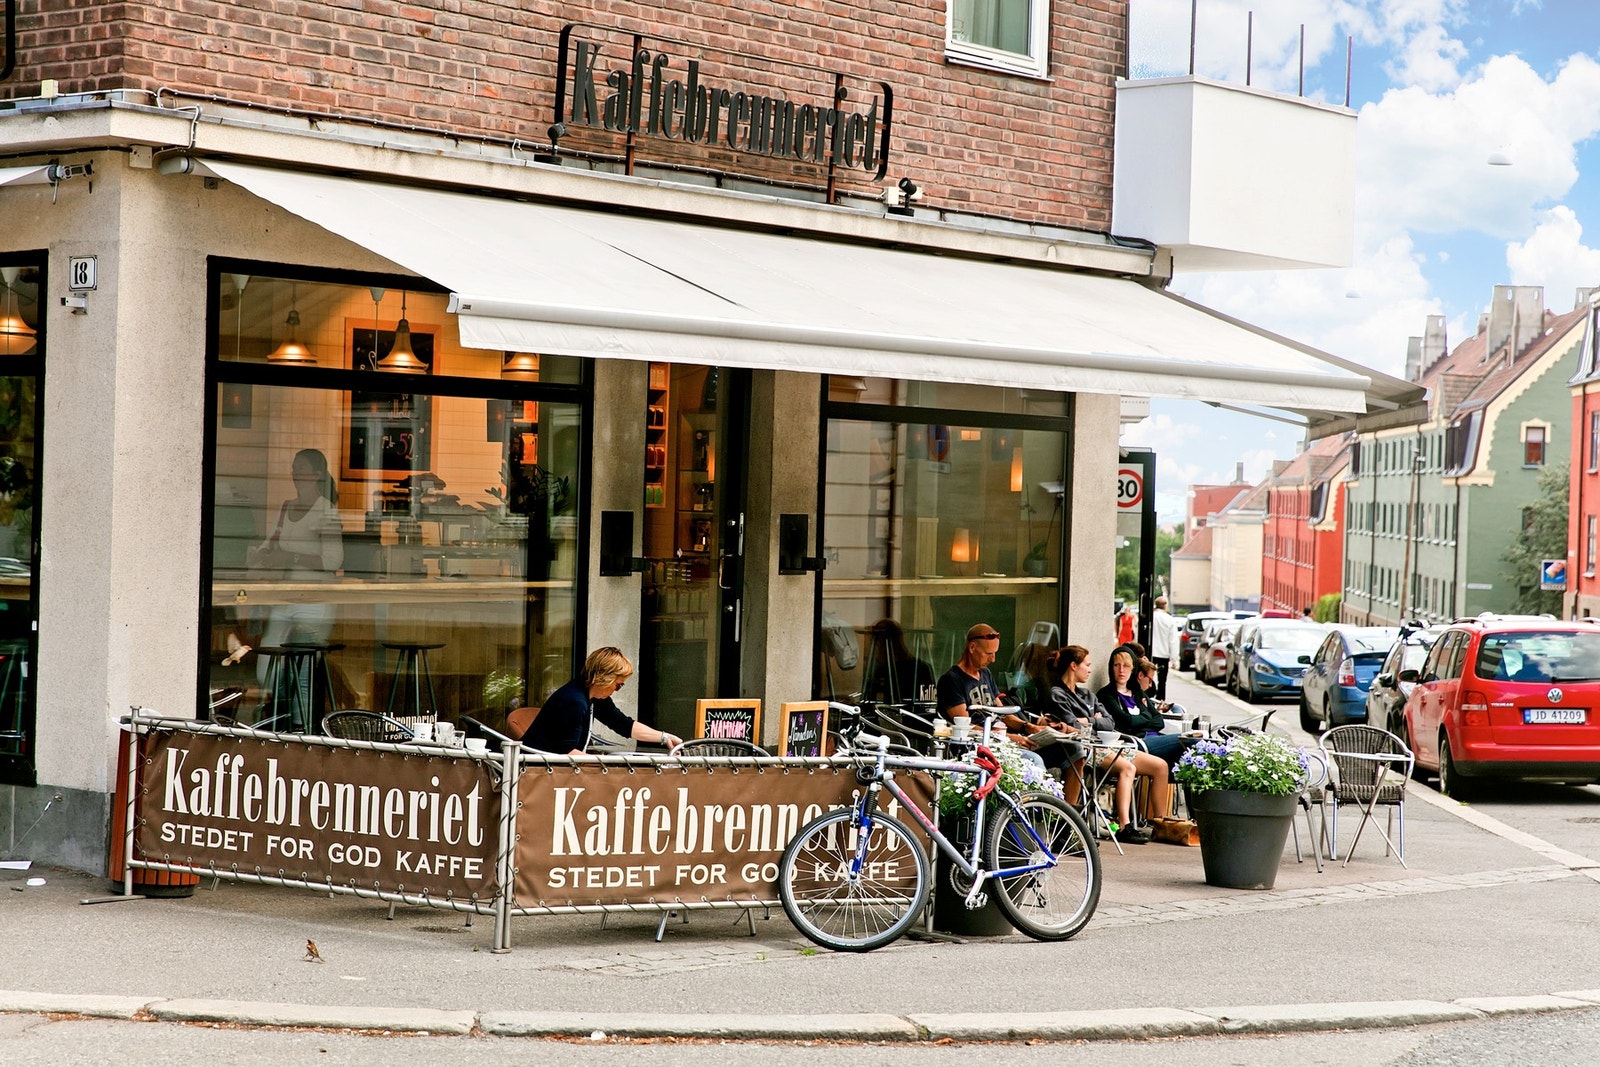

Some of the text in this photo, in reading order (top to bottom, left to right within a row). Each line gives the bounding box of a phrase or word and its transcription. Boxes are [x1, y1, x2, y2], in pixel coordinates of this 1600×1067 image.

[571, 40, 880, 170] Kaffebrenneriet
[74, 261, 88, 285] 18
[1117, 480, 1138, 498] 30
[1535, 708, 1582, 720] JD 41209
[162, 747, 485, 848] Kaffebrenneriet
[160, 822, 484, 880] STEDET FOR GOD KAFFE
[547, 865, 661, 889] STEDET
[675, 863, 728, 886] FOR
[814, 862, 900, 883] KAFE
